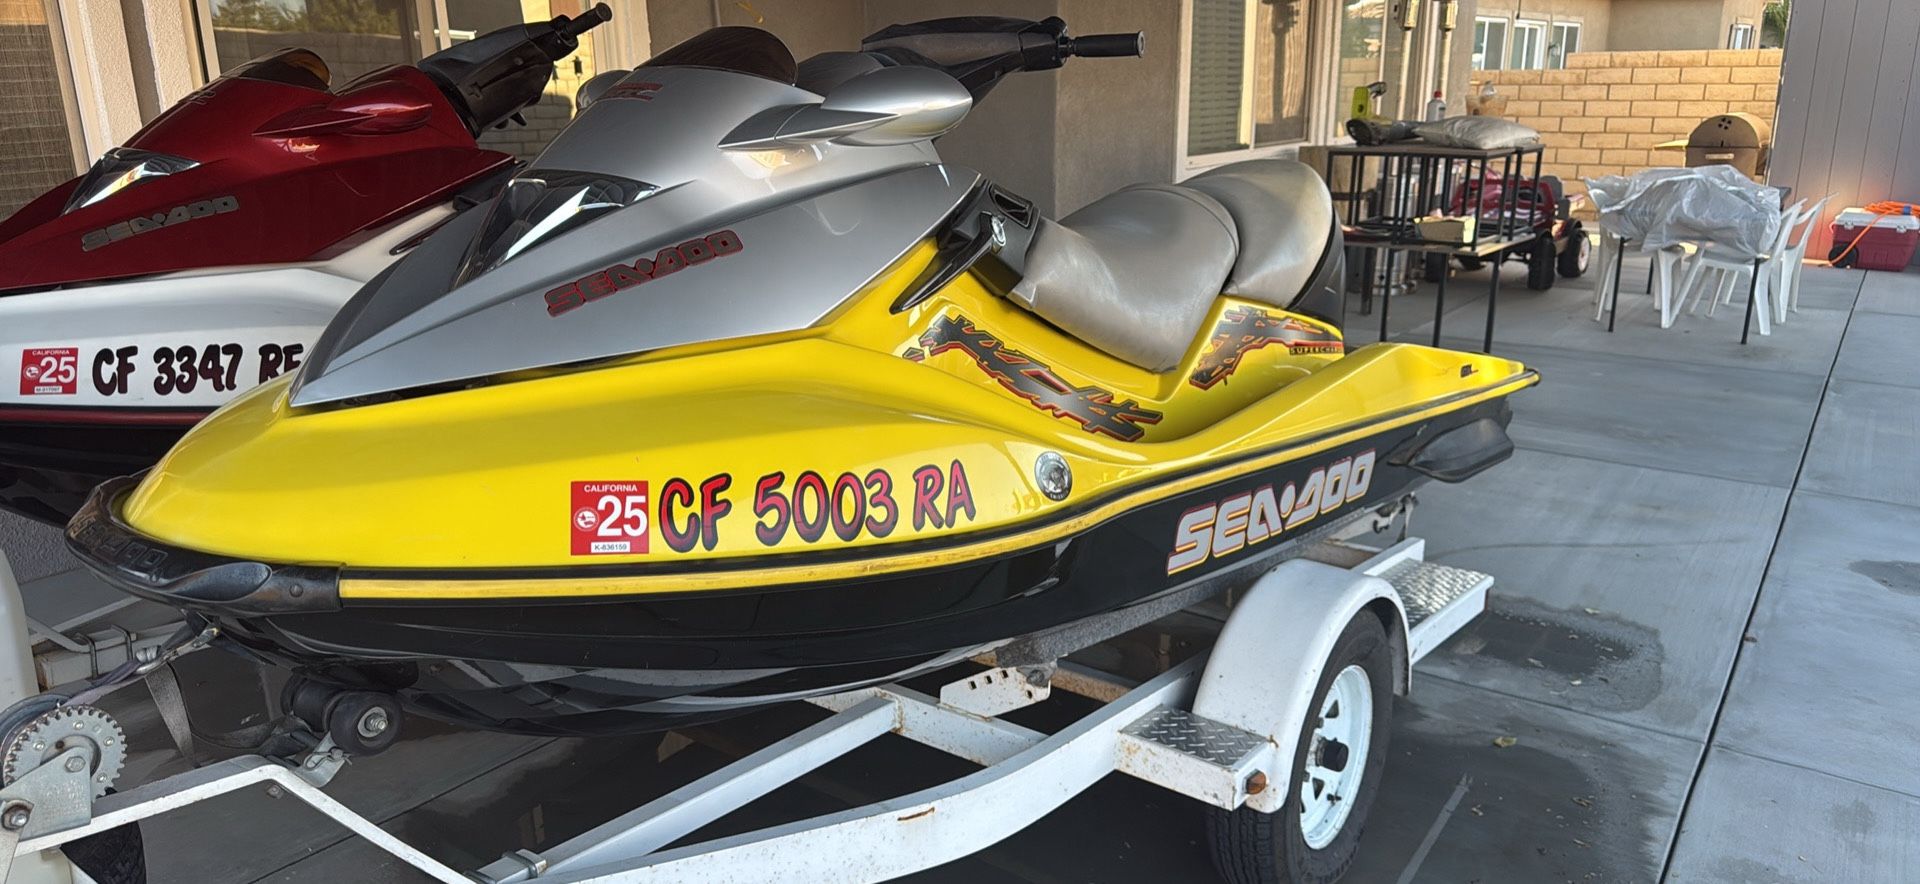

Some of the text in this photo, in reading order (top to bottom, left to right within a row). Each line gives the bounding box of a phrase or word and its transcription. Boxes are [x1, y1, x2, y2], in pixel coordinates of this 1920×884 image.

[39, 356, 76, 384] 25
[92, 345, 138, 396] CF
[153, 343, 243, 396] 3347
[583, 484, 638, 493] CALIFORNIA
[658, 458, 977, 553] CF 5003 RA
[596, 494, 648, 538] 25
